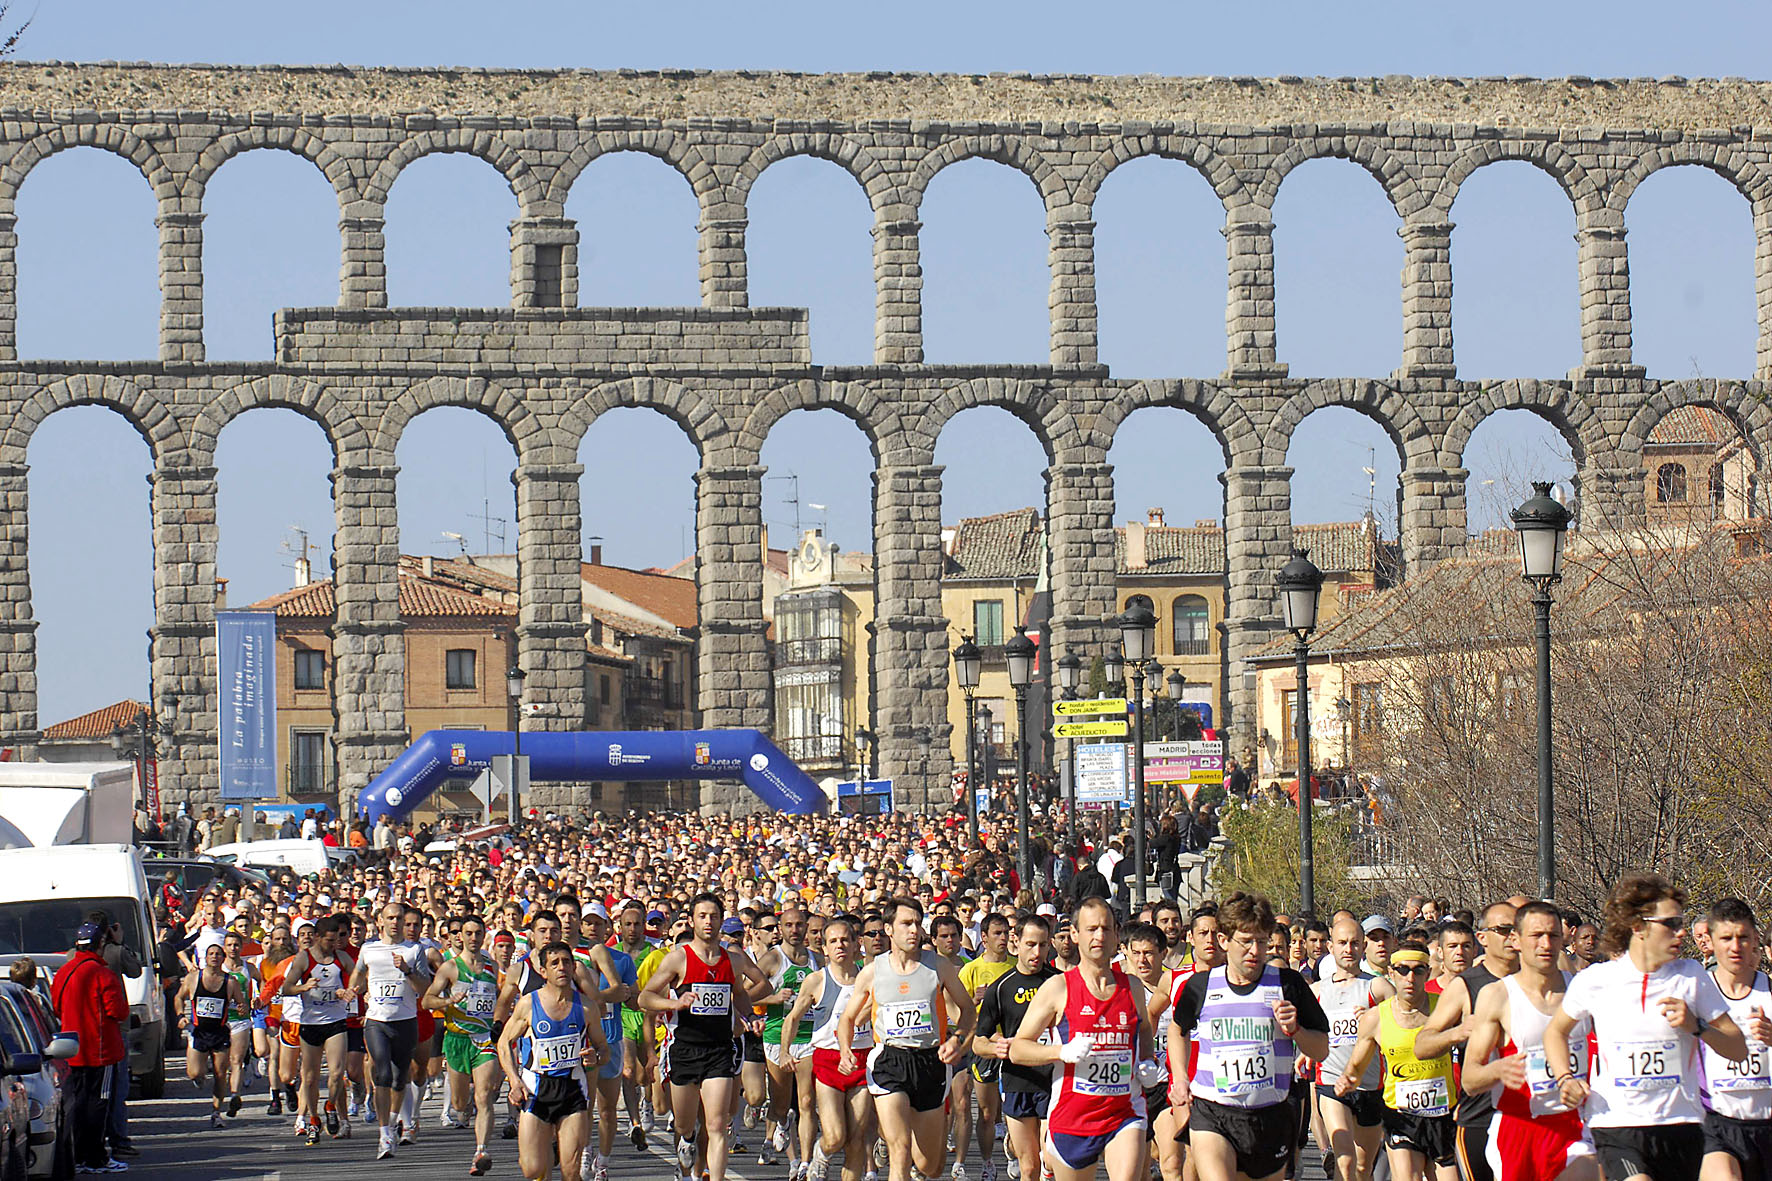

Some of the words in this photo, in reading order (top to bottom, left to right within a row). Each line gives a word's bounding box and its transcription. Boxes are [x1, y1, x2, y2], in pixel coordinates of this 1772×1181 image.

[242, 634, 256, 707] imaginada
[232, 671, 246, 724] palabra
[232, 730, 244, 748] La
[322, 991, 332, 1000] 21
[380, 985, 396, 996] 127
[703, 992, 723, 1006] 683
[205, 1002, 215, 1012] 45
[476, 1000, 493, 1011] 663
[896, 1010, 921, 1027] 672
[1333, 1018, 1358, 1036] 628
[1225, 1018, 1274, 1040] Vaillant
[545, 1044, 575, 1061] 1197
[1088, 1063, 1120, 1083] 248
[1221, 1056, 1267, 1081] 1143
[1545, 1053, 1579, 1078] 69
[1628, 1051, 1664, 1076] 125
[1727, 1054, 1761, 1076] 405
[1406, 1089, 1437, 1110] 1607
